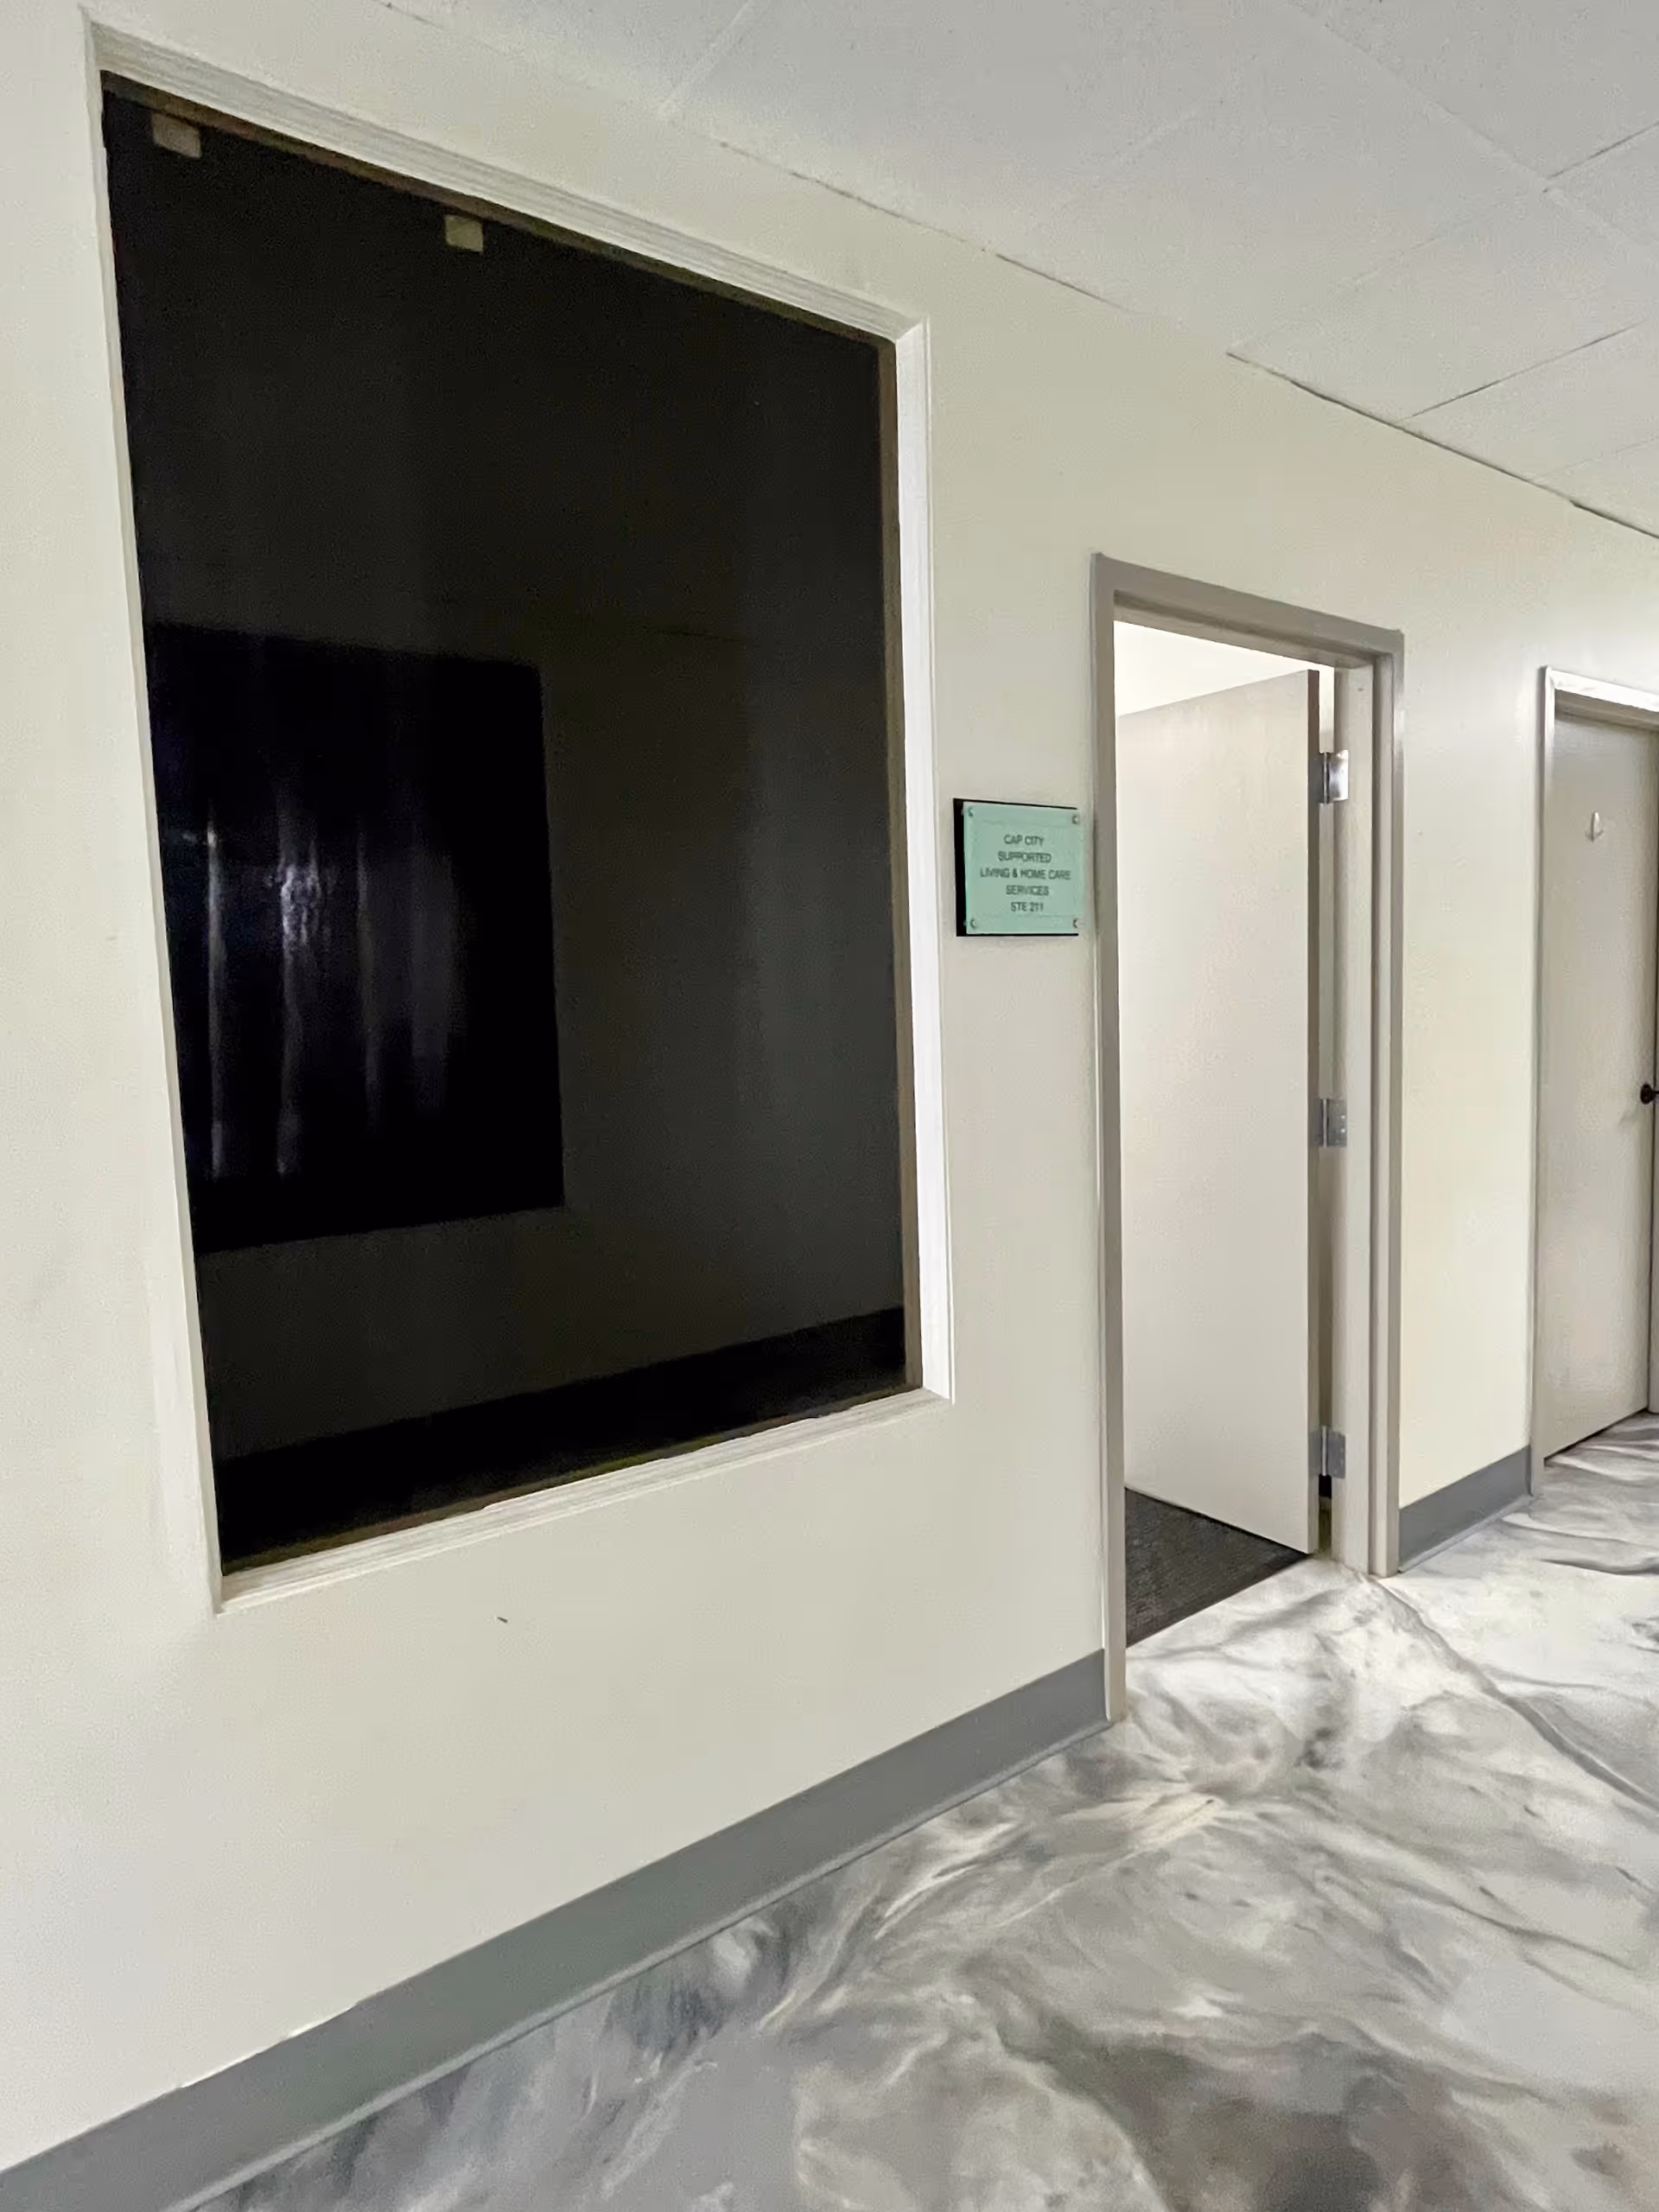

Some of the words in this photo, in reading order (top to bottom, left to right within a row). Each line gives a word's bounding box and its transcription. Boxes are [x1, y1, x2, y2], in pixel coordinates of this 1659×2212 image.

[1003, 834, 1023, 845] CAP
[1025, 835, 1045, 846] CITY
[997, 850, 1052, 863] SUPPORTED
[980, 868, 1010, 879] LIVING
[1012, 868, 1018, 879] &
[1020, 868, 1046, 880] HOME
[1048, 869, 1071, 880] CARE
[1006, 884, 1050, 896] SERVICES
[1010, 901, 1027, 912] STE
